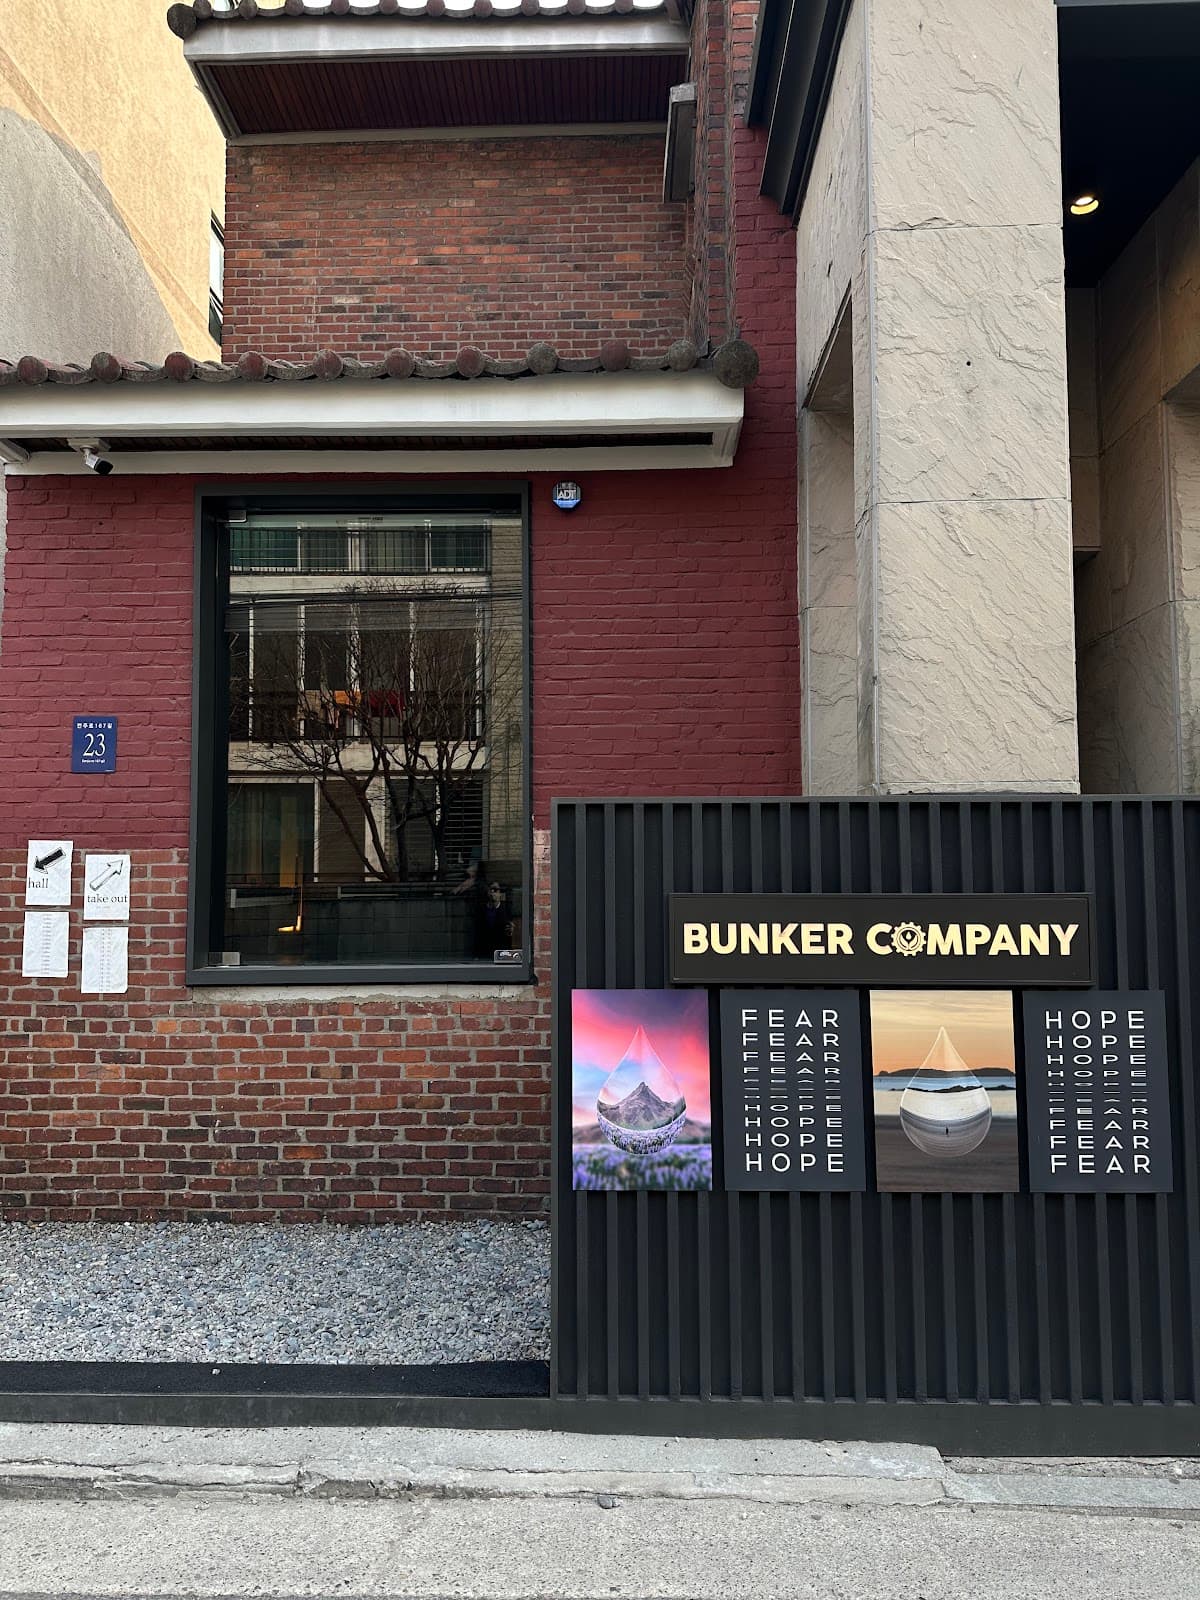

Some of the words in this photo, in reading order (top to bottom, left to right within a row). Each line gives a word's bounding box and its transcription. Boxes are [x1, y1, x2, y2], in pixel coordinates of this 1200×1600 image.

[558, 489, 576, 500] ADT
[83, 733, 106, 757] 23
[28, 877, 49, 889] hall
[87, 893, 109, 903] take
[111, 895, 128, 903] out
[683, 922, 855, 955] BUNKER
[742, 1009, 838, 1028] FEAR
[1046, 1010, 1145, 1030] HOPE
[743, 1033, 840, 1047] FEAR
[1047, 1035, 1146, 1049] HOPE
[743, 1052, 841, 1062] FEAR
[1047, 1054, 1147, 1065] HOPE
[745, 1117, 843, 1128] HOPE
[1050, 1120, 1150, 1131] FEAR
[746, 1133, 843, 1148] HOPE
[1051, 1136, 1150, 1150] FEAR
[746, 1153, 844, 1173] HOPE
[1051, 1155, 1151, 1174] FEAR
